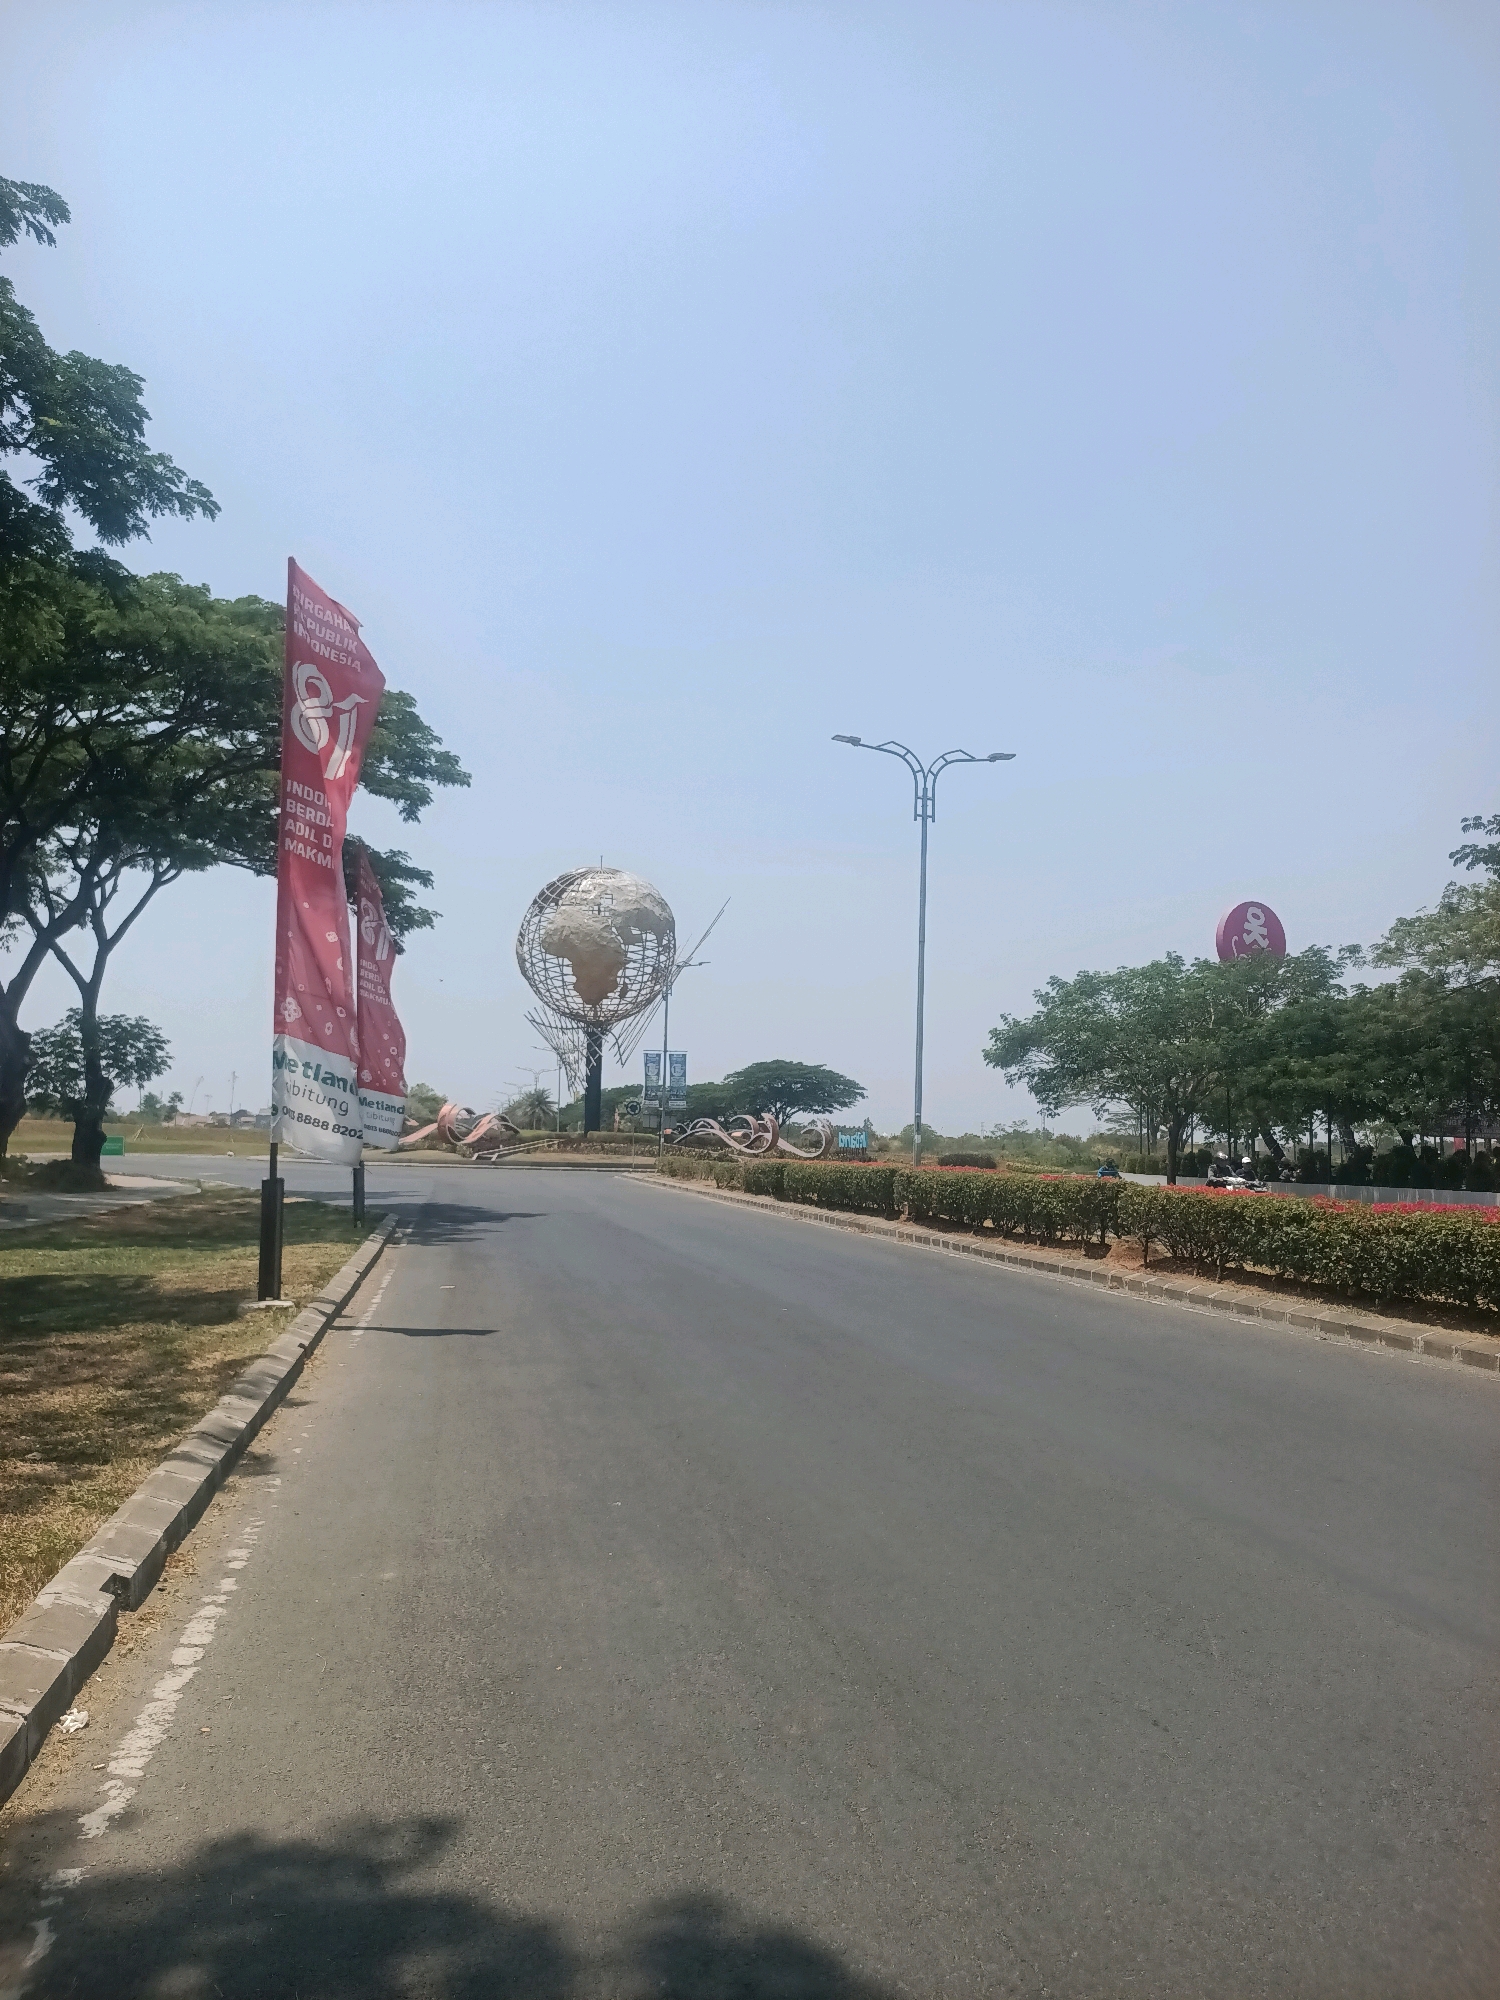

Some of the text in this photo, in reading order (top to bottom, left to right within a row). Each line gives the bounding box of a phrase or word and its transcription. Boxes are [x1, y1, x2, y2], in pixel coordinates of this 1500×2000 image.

[291, 660, 369, 781] 81
[285, 818, 318, 844] ADIL
[285, 837, 335, 870] MAKM
[360, 959, 378, 972] INDO
[360, 988, 391, 1006] MAKMU
[359, 1096, 405, 1115] Metland
[296, 1112, 330, 1131] 8888
[332, 1123, 364, 1140] 8202
